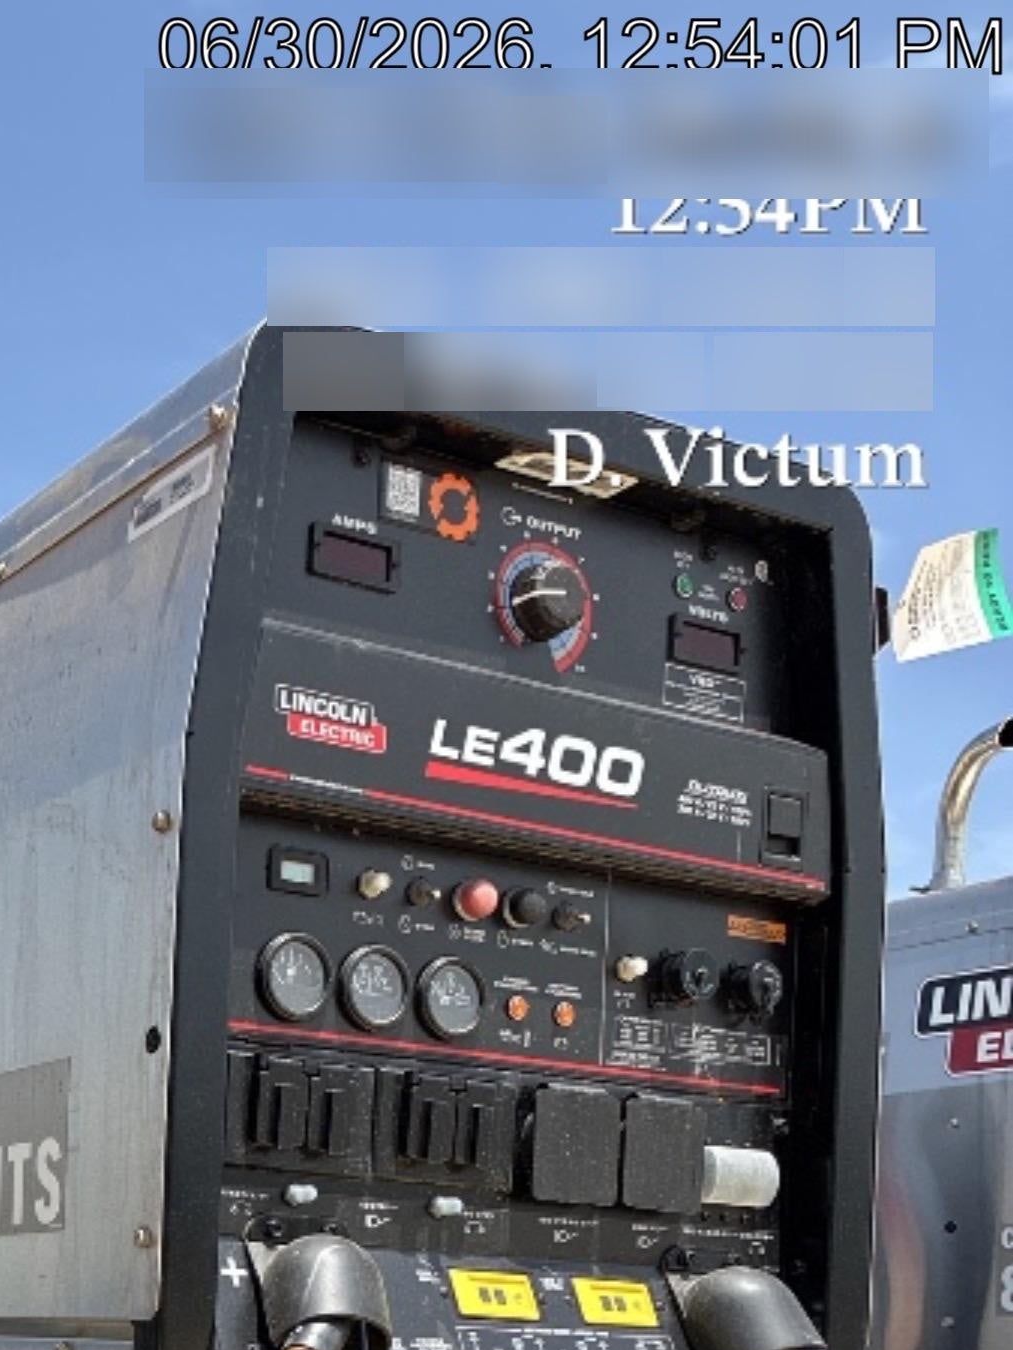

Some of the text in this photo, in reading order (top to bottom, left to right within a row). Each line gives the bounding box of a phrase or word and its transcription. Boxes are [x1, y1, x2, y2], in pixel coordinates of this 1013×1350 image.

[331, 512, 378, 534] AMPS
[526, 516, 582, 539] OUTPUT
[279, 689, 367, 727] LINCOLN
[300, 718, 376, 748] ELECTRIC
[428, 718, 646, 798] LE400
